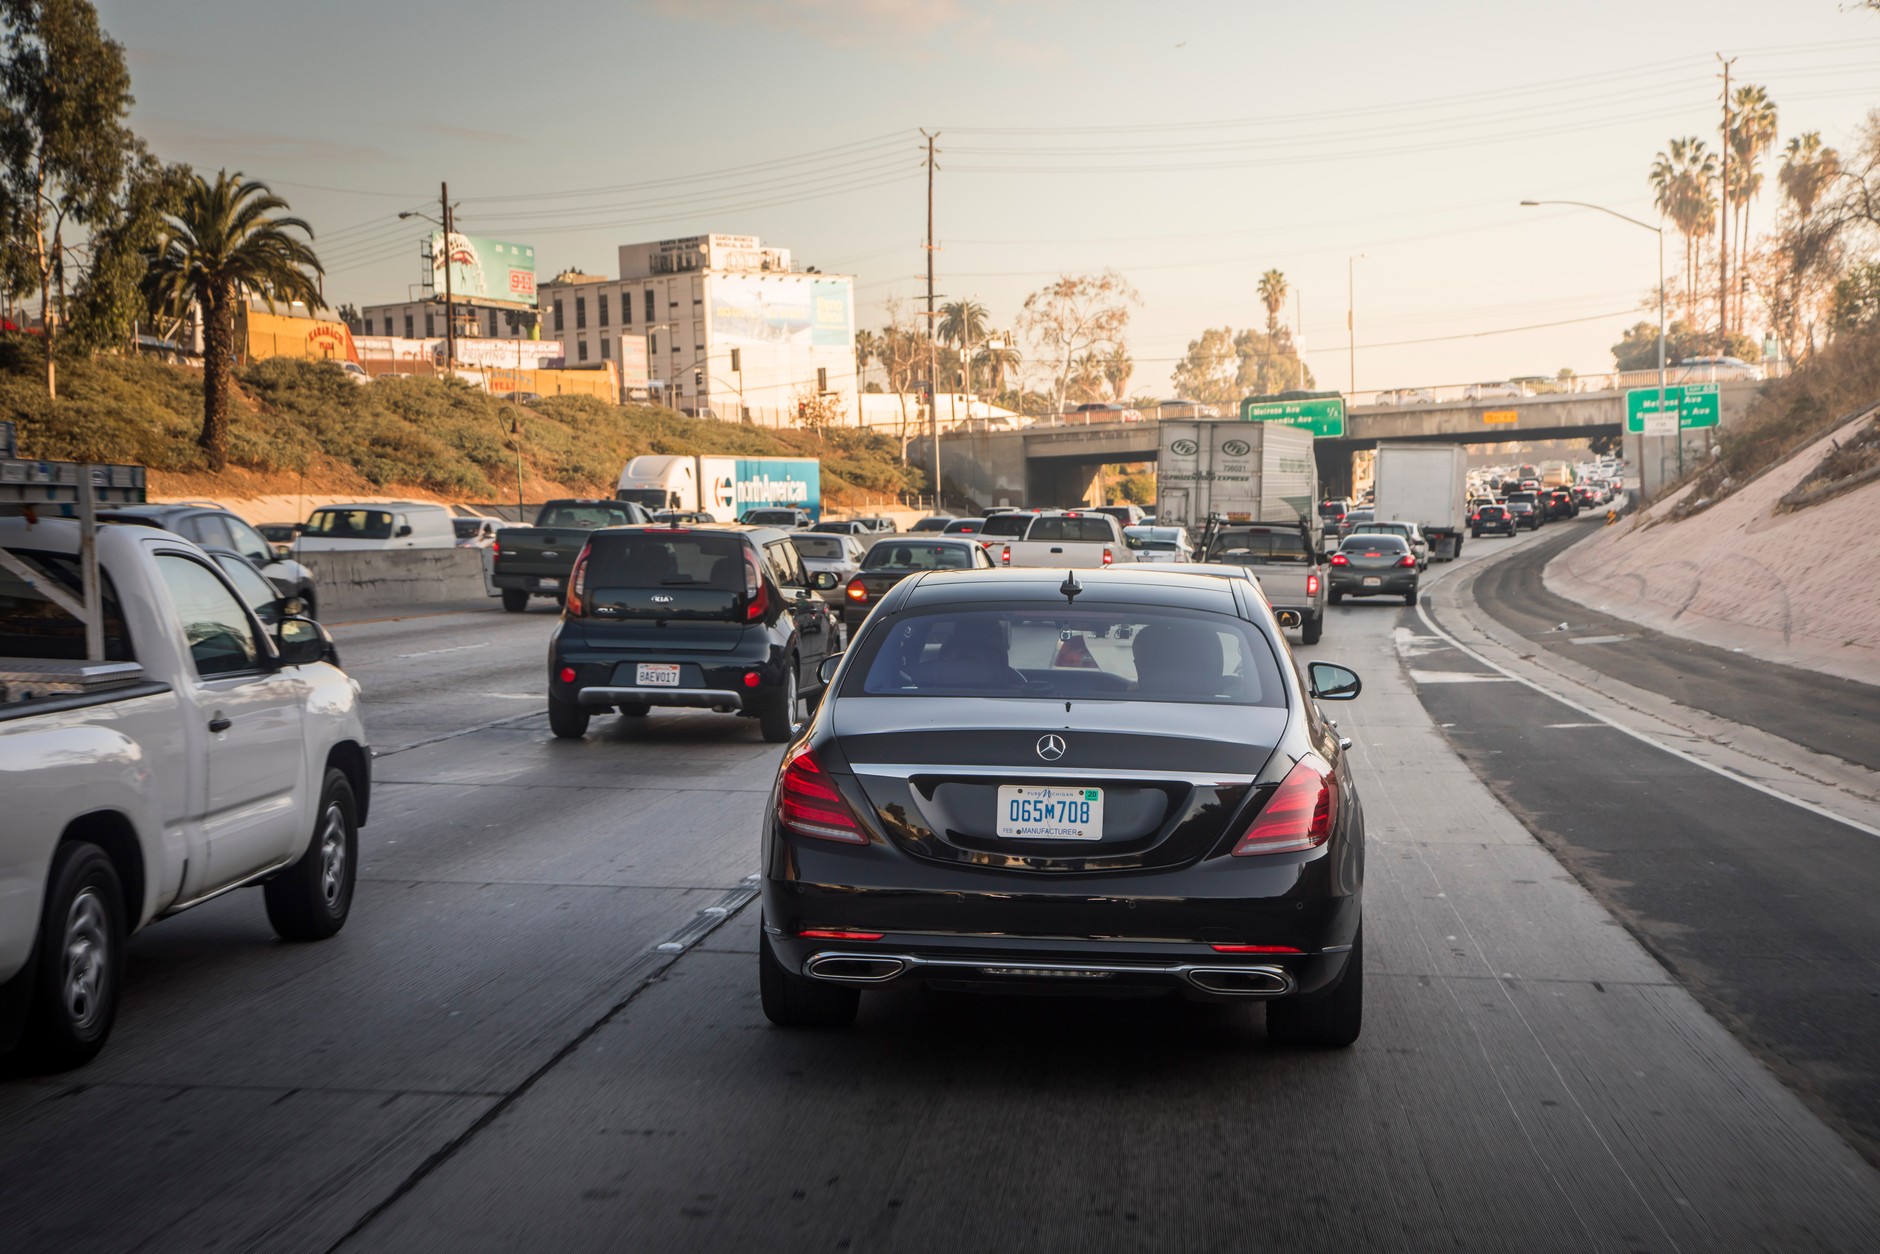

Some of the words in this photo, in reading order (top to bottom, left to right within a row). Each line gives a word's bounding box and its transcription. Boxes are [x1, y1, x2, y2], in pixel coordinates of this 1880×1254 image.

[1683, 396, 1702, 404] Ave
[1253, 407, 1283, 416] Melrose
[1285, 406, 1300, 414] Ave
[1691, 407, 1711, 416] Ave
[737, 474, 808, 503] northAmerican
[640, 671, 677, 683] 8AEV017
[1009, 799, 1090, 824] 065M708
[1021, 827, 1078, 836] MANUFACTURER
